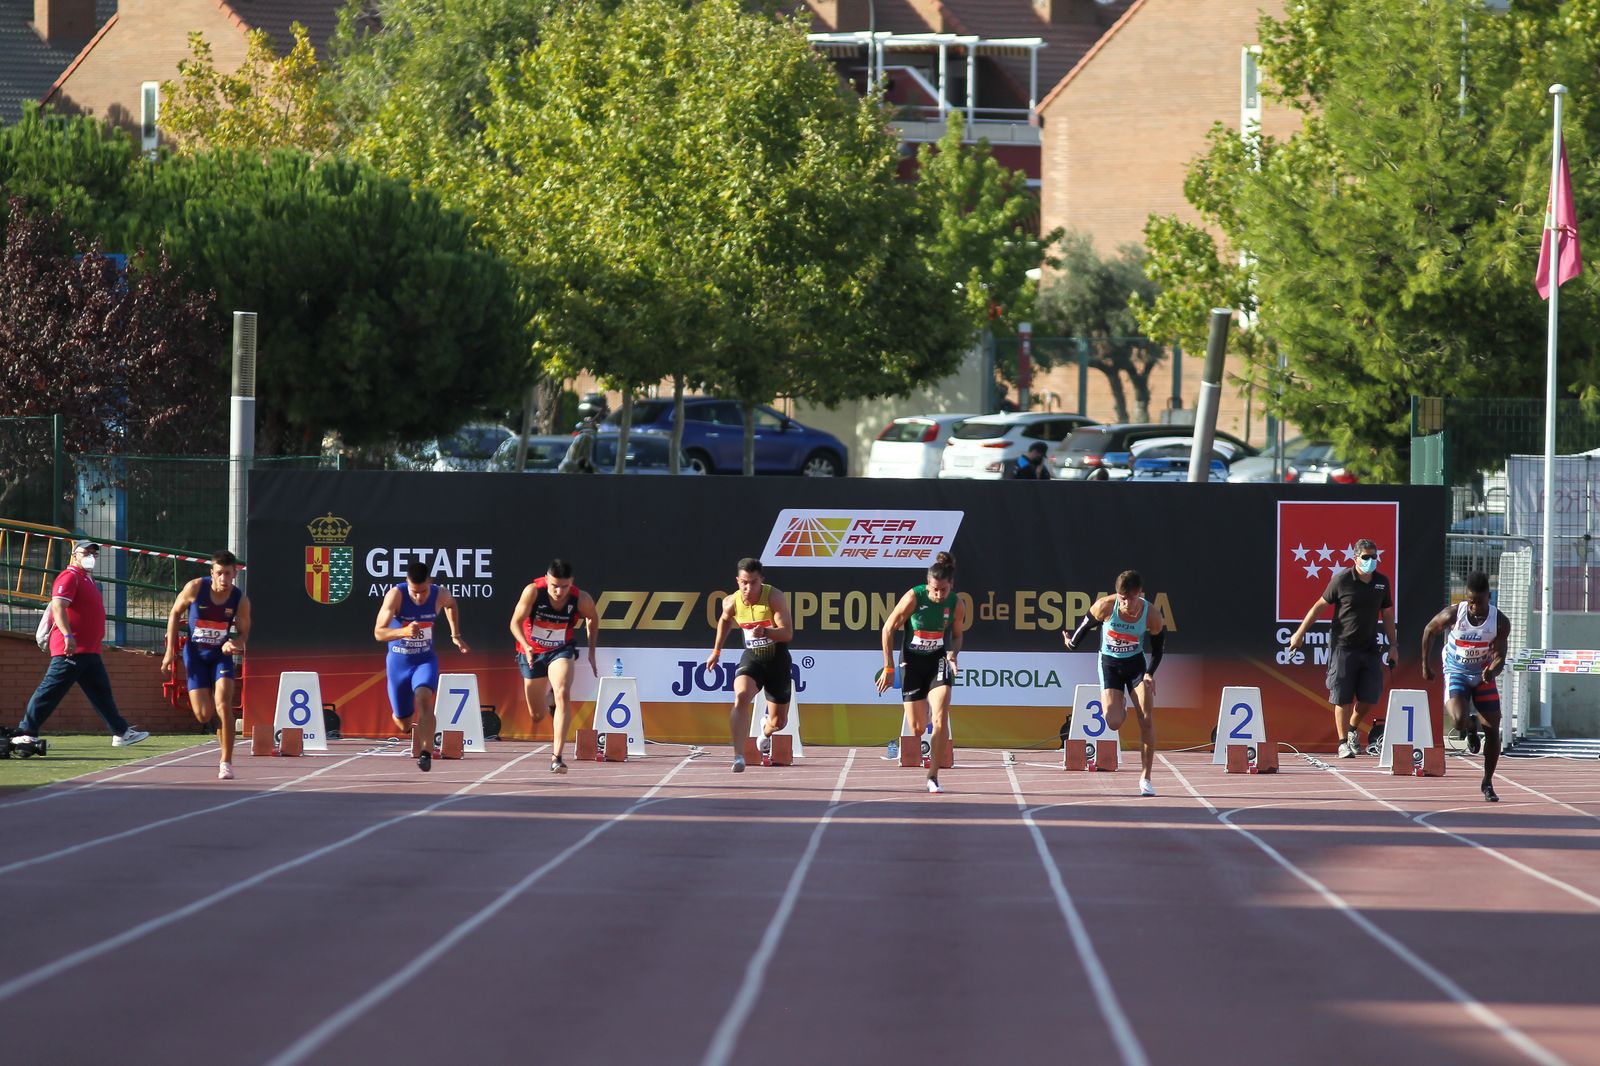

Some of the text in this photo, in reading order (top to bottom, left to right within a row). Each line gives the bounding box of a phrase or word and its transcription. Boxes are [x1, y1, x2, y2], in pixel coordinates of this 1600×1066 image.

[846, 535, 944, 545] ATLETISMO
[852, 519, 917, 534] RFEA
[365, 547, 493, 578] GETAFE
[840, 548, 932, 560] AIRE LIBRE
[706, 590, 974, 631] CPEONO
[979, 591, 1010, 620] de
[1015, 590, 1177, 632] ESPA
[545, 629, 553, 639] 7
[1275, 646, 1306, 665] de
[951, 669, 1062, 688] ERDROLA
[288, 688, 312, 726] 8
[448, 688, 470, 725] 7
[606, 692, 631, 729] 6
[1083, 700, 1106, 737] 3
[1229, 702, 1253, 739] 2
[1401, 705, 1415, 742] 1
